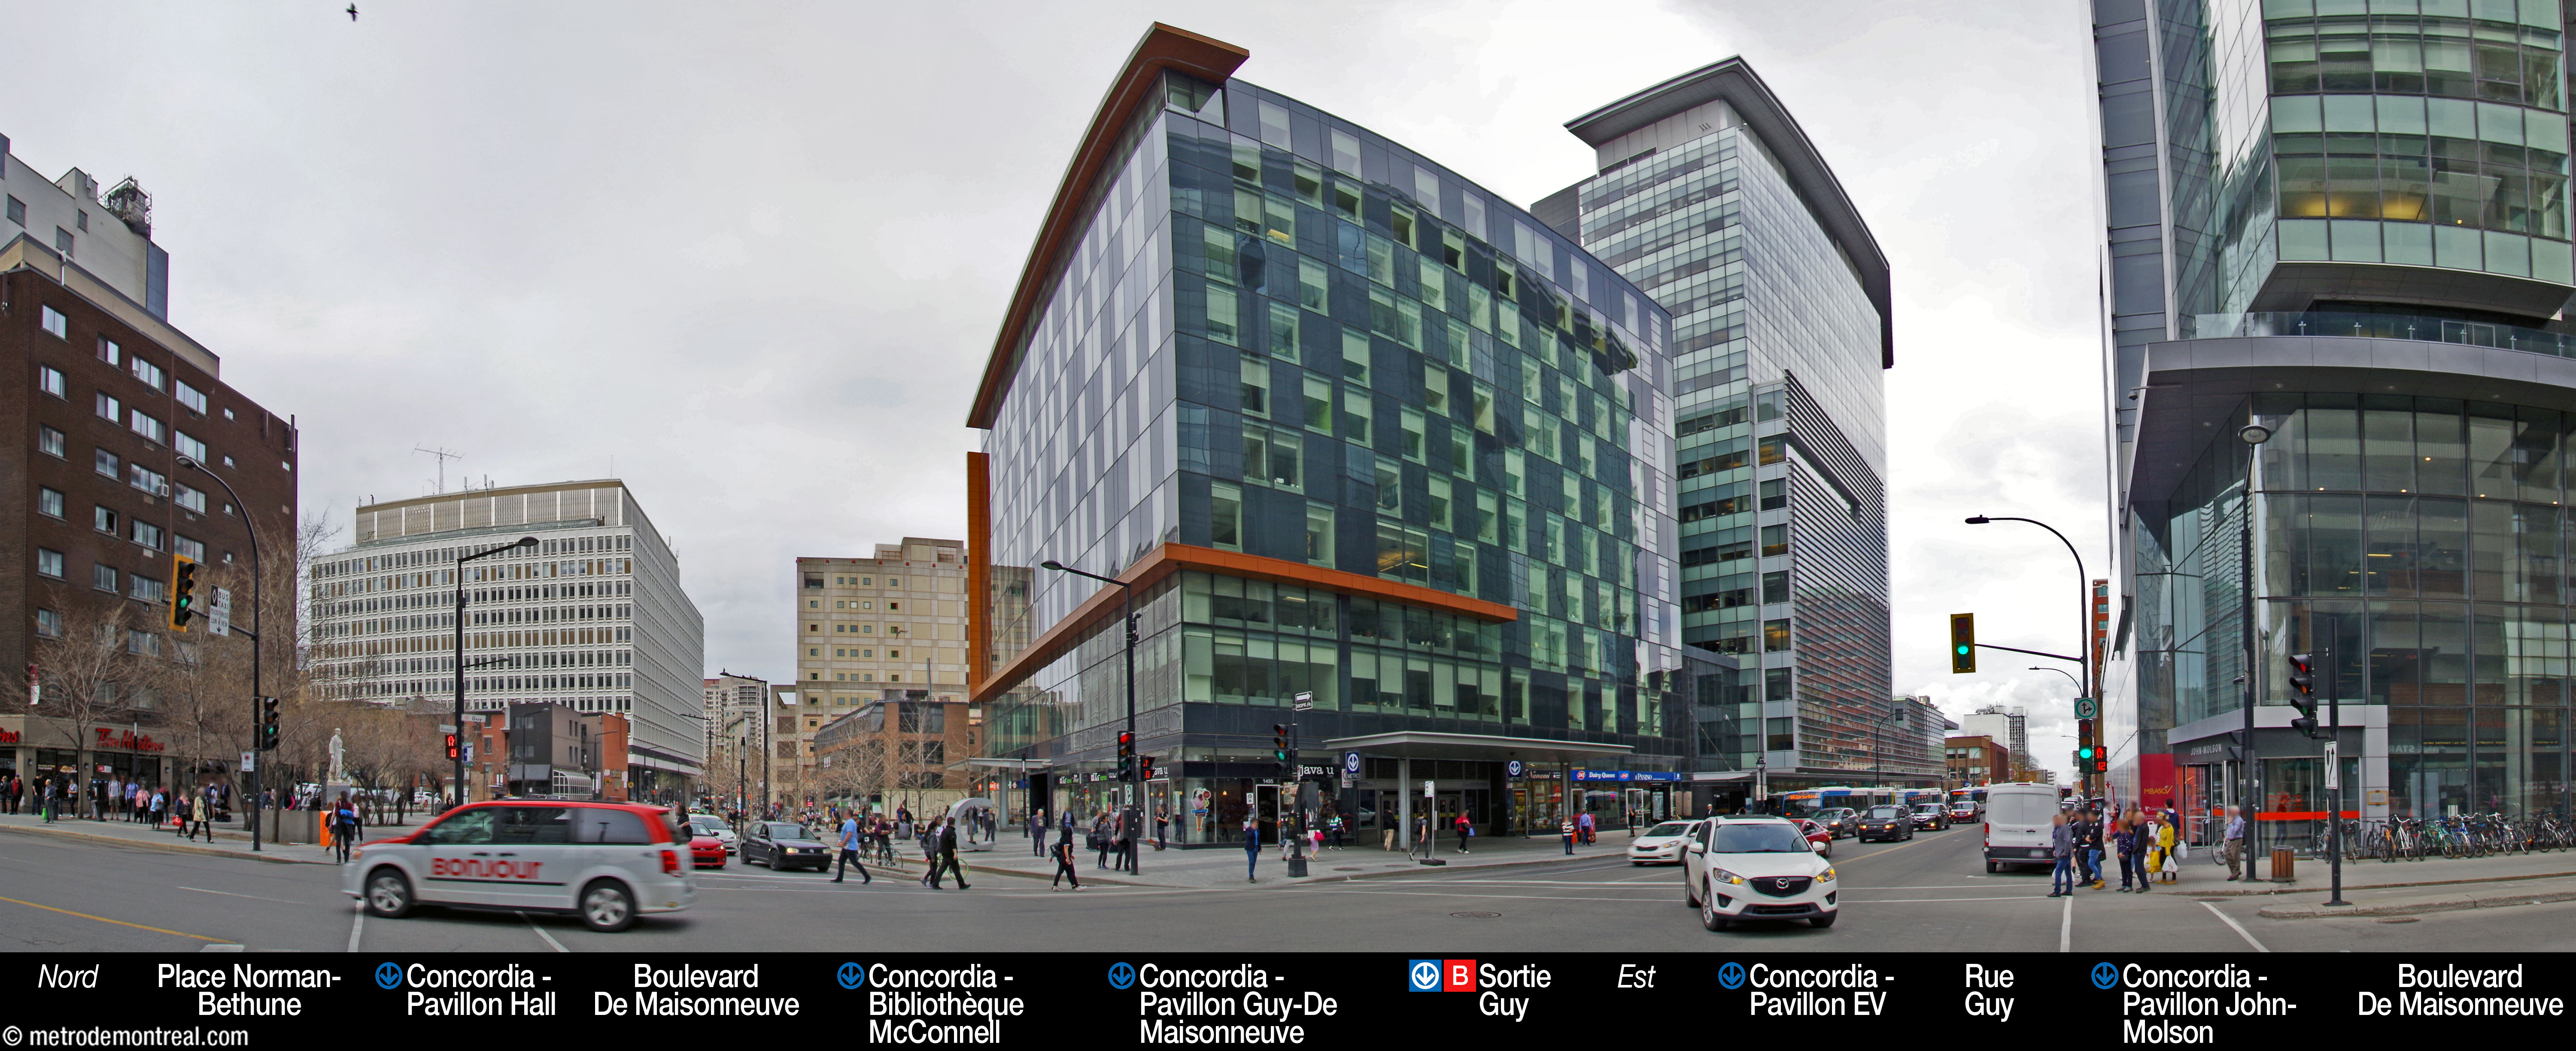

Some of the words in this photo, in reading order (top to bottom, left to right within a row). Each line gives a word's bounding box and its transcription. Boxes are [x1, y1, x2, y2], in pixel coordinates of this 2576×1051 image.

[219, 592, 228, 601] BUS
[218, 601, 228, 610] TAXI
[96, 728, 119, 748] Tim
[2098, 762, 2105, 770] 12
[1152, 766, 1163, 778] java
[1300, 765, 1324, 777] java
[1525, 769, 1551, 778] Nanami
